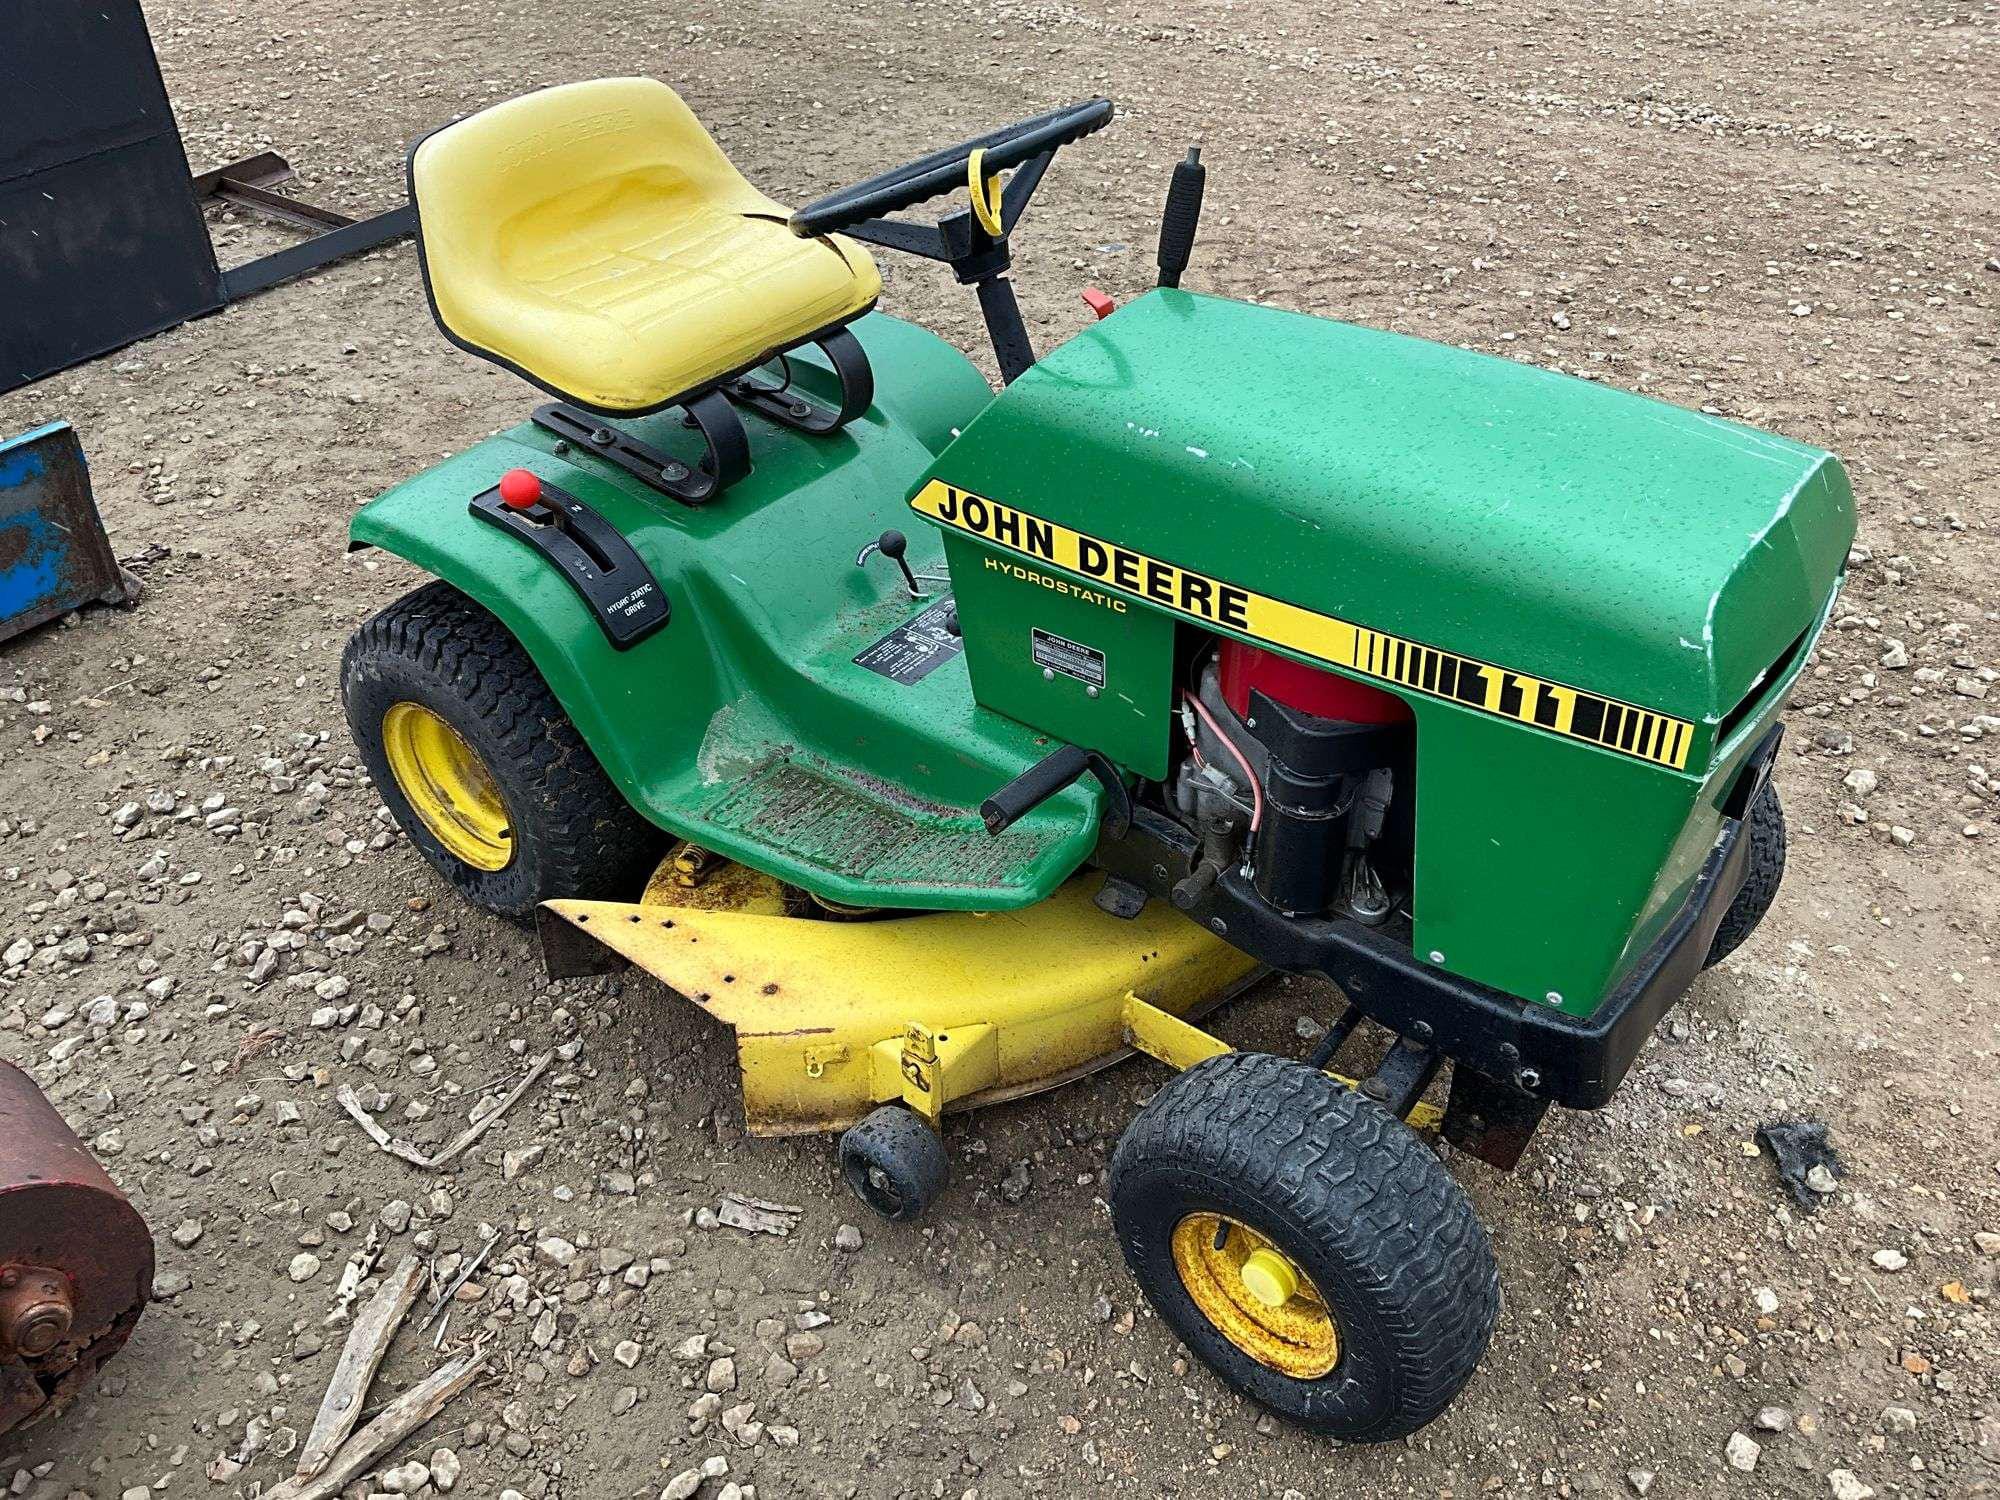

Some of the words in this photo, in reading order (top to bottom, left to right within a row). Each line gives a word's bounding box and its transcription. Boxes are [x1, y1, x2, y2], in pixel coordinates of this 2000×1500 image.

[938, 487, 1054, 561] JOHN
[1079, 538, 1249, 630] DEERE
[985, 557, 1128, 615] HYDROSTATIC
[624, 599, 647, 617] DRIVE
[1047, 635, 1066, 647] JOHN
[1066, 643, 1090, 656] DEERE
[1476, 664, 1577, 733] 111
